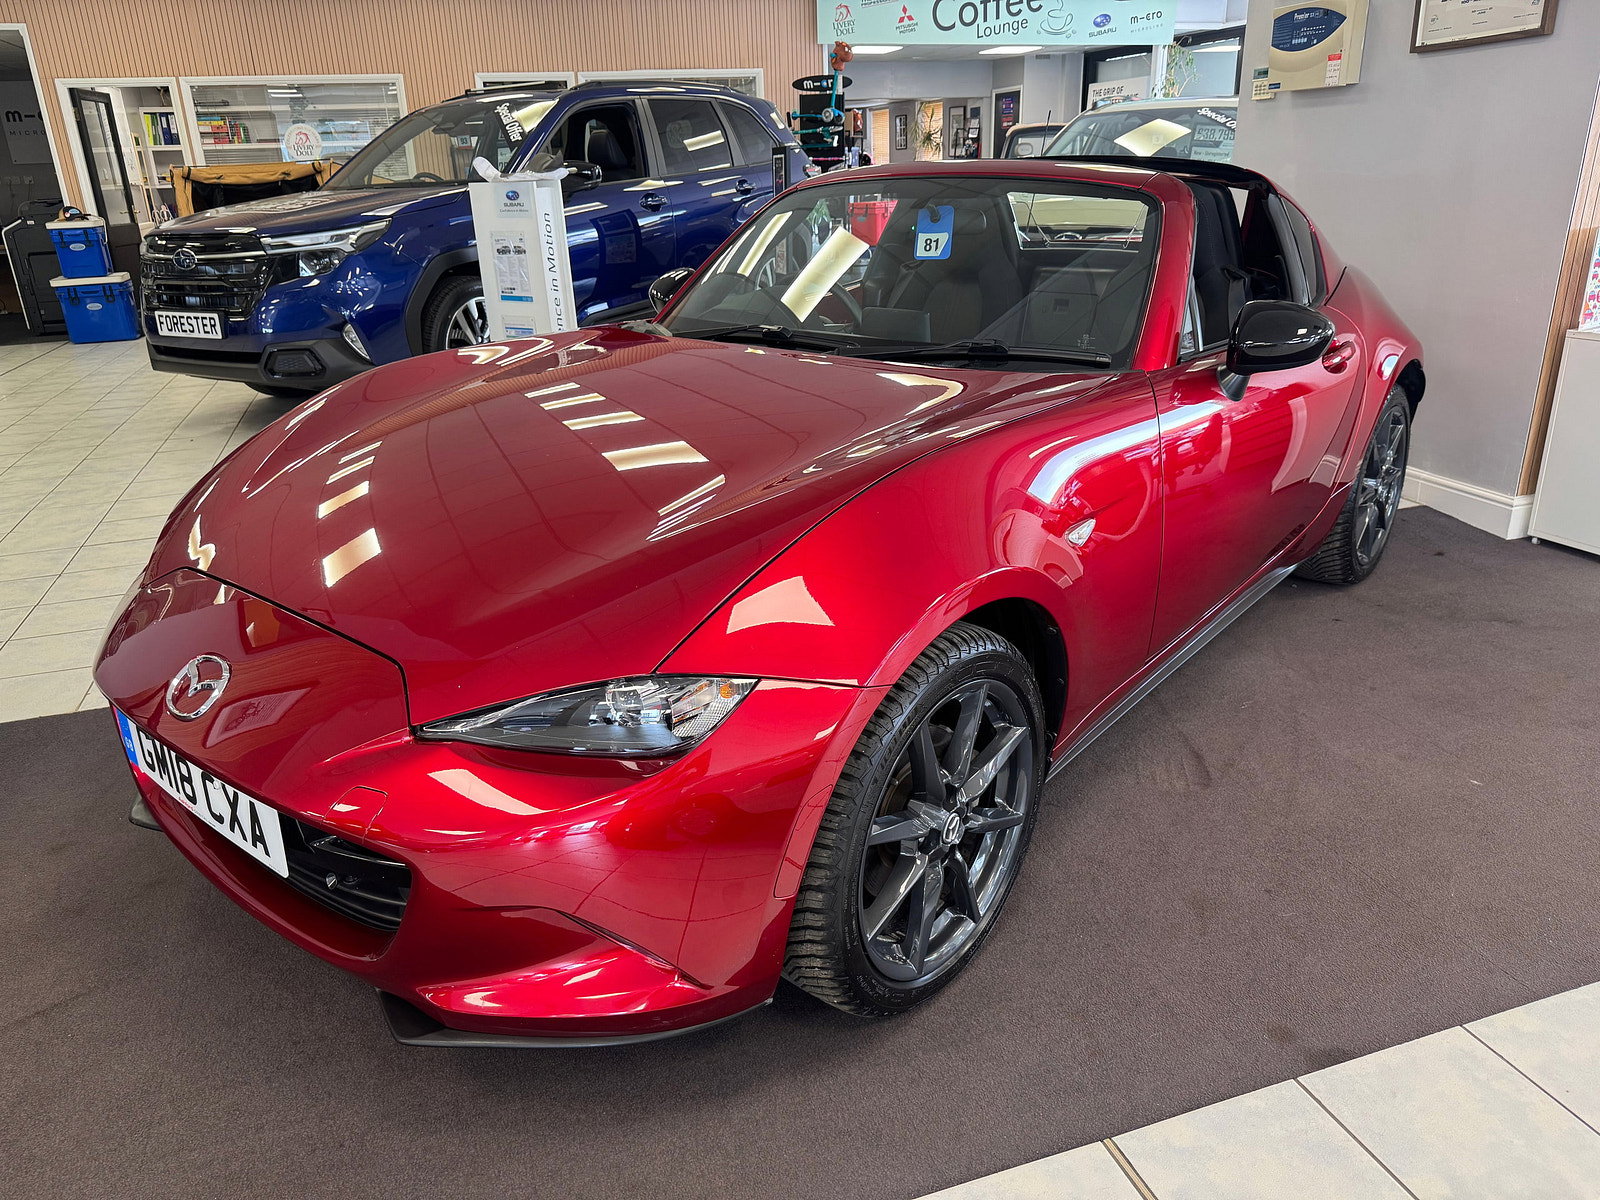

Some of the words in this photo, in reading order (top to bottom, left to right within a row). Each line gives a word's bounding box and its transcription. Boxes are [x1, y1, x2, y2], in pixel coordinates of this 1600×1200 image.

[833, 19, 856, 30] LIVERY
[836, 27, 856, 37] DOLE
[976, 18, 1029, 39] Lounge
[1088, 27, 1117, 38] SUBARU
[1093, 89, 1102, 97] THE
[1103, 87, 1115, 96] GRIP
[1117, 86, 1124, 94] OF
[494, 102, 513, 125] Special
[505, 121, 523, 142] Offer
[1197, 107, 1232, 124] Special
[543, 212, 557, 273] Motion
[924, 238, 939, 252] 81
[550, 278, 559, 292] in
[554, 297, 564, 331] nce
[158, 314, 218, 335] FORESTER
[136, 724, 197, 806] GM18
[201, 769, 271, 858] CXA
